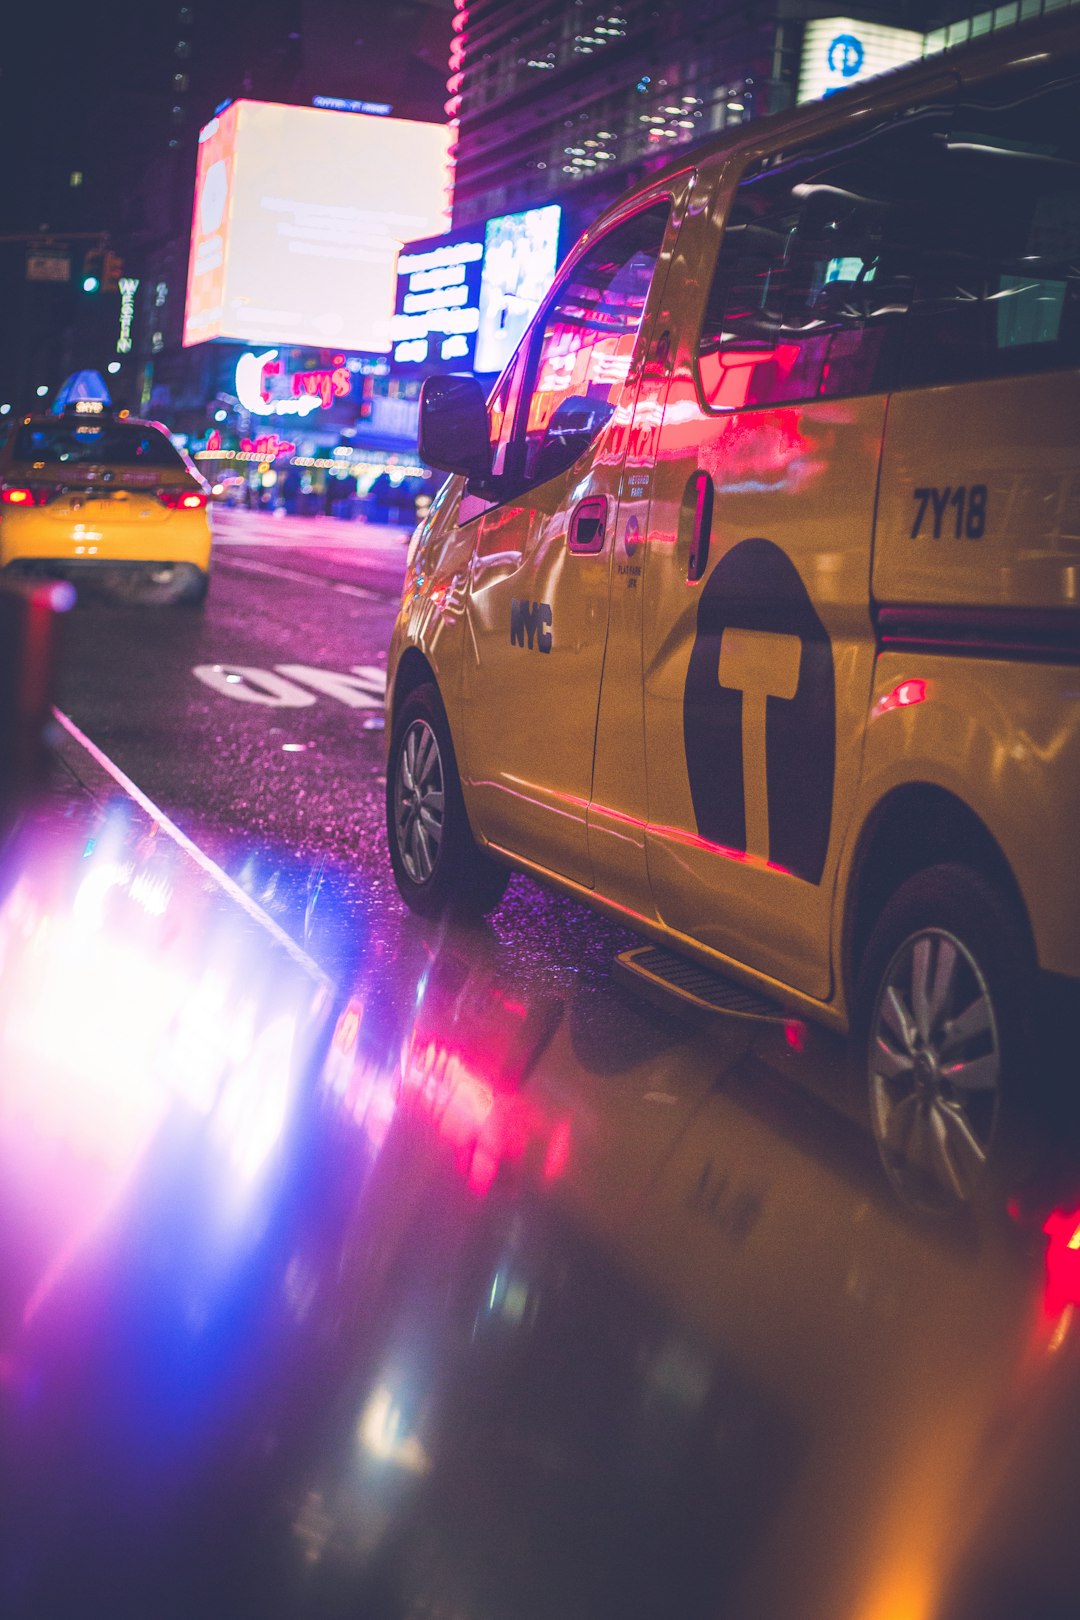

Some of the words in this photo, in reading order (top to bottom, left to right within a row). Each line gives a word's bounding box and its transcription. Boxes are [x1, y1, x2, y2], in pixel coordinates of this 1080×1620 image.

[631, 487, 643, 497] FARE
[911, 484, 988, 540] 7Y18
[511, 598, 553, 654] NYC
